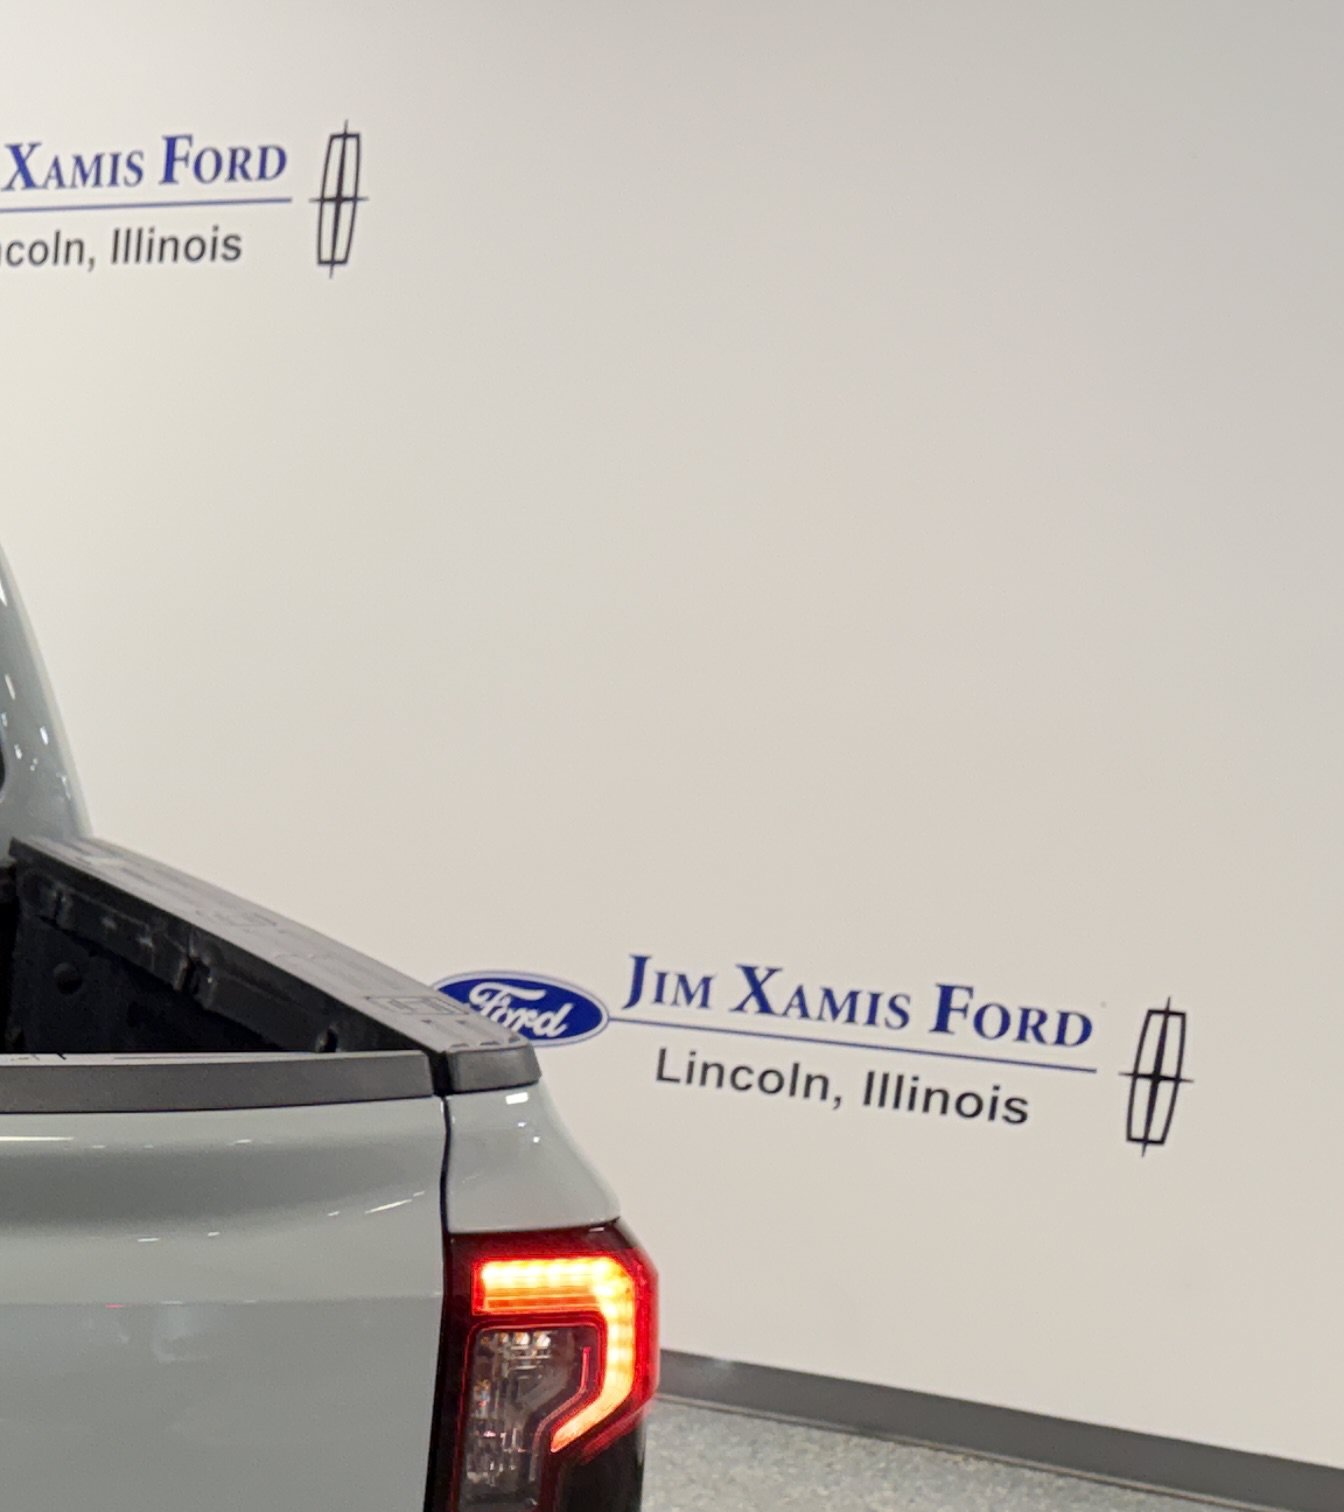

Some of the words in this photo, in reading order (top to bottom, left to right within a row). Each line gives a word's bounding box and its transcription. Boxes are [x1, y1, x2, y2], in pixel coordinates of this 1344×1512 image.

[0, 142, 145, 192] XAMIS
[160, 135, 288, 185] FORD
[110, 227, 243, 266] Illinois
[622, 954, 718, 1012] JIM
[728, 964, 911, 1031] XAMIS
[929, 983, 1094, 1051] FORD
[654, 1047, 845, 1112] Lincoln,
[862, 1070, 1030, 1126] Illinois
